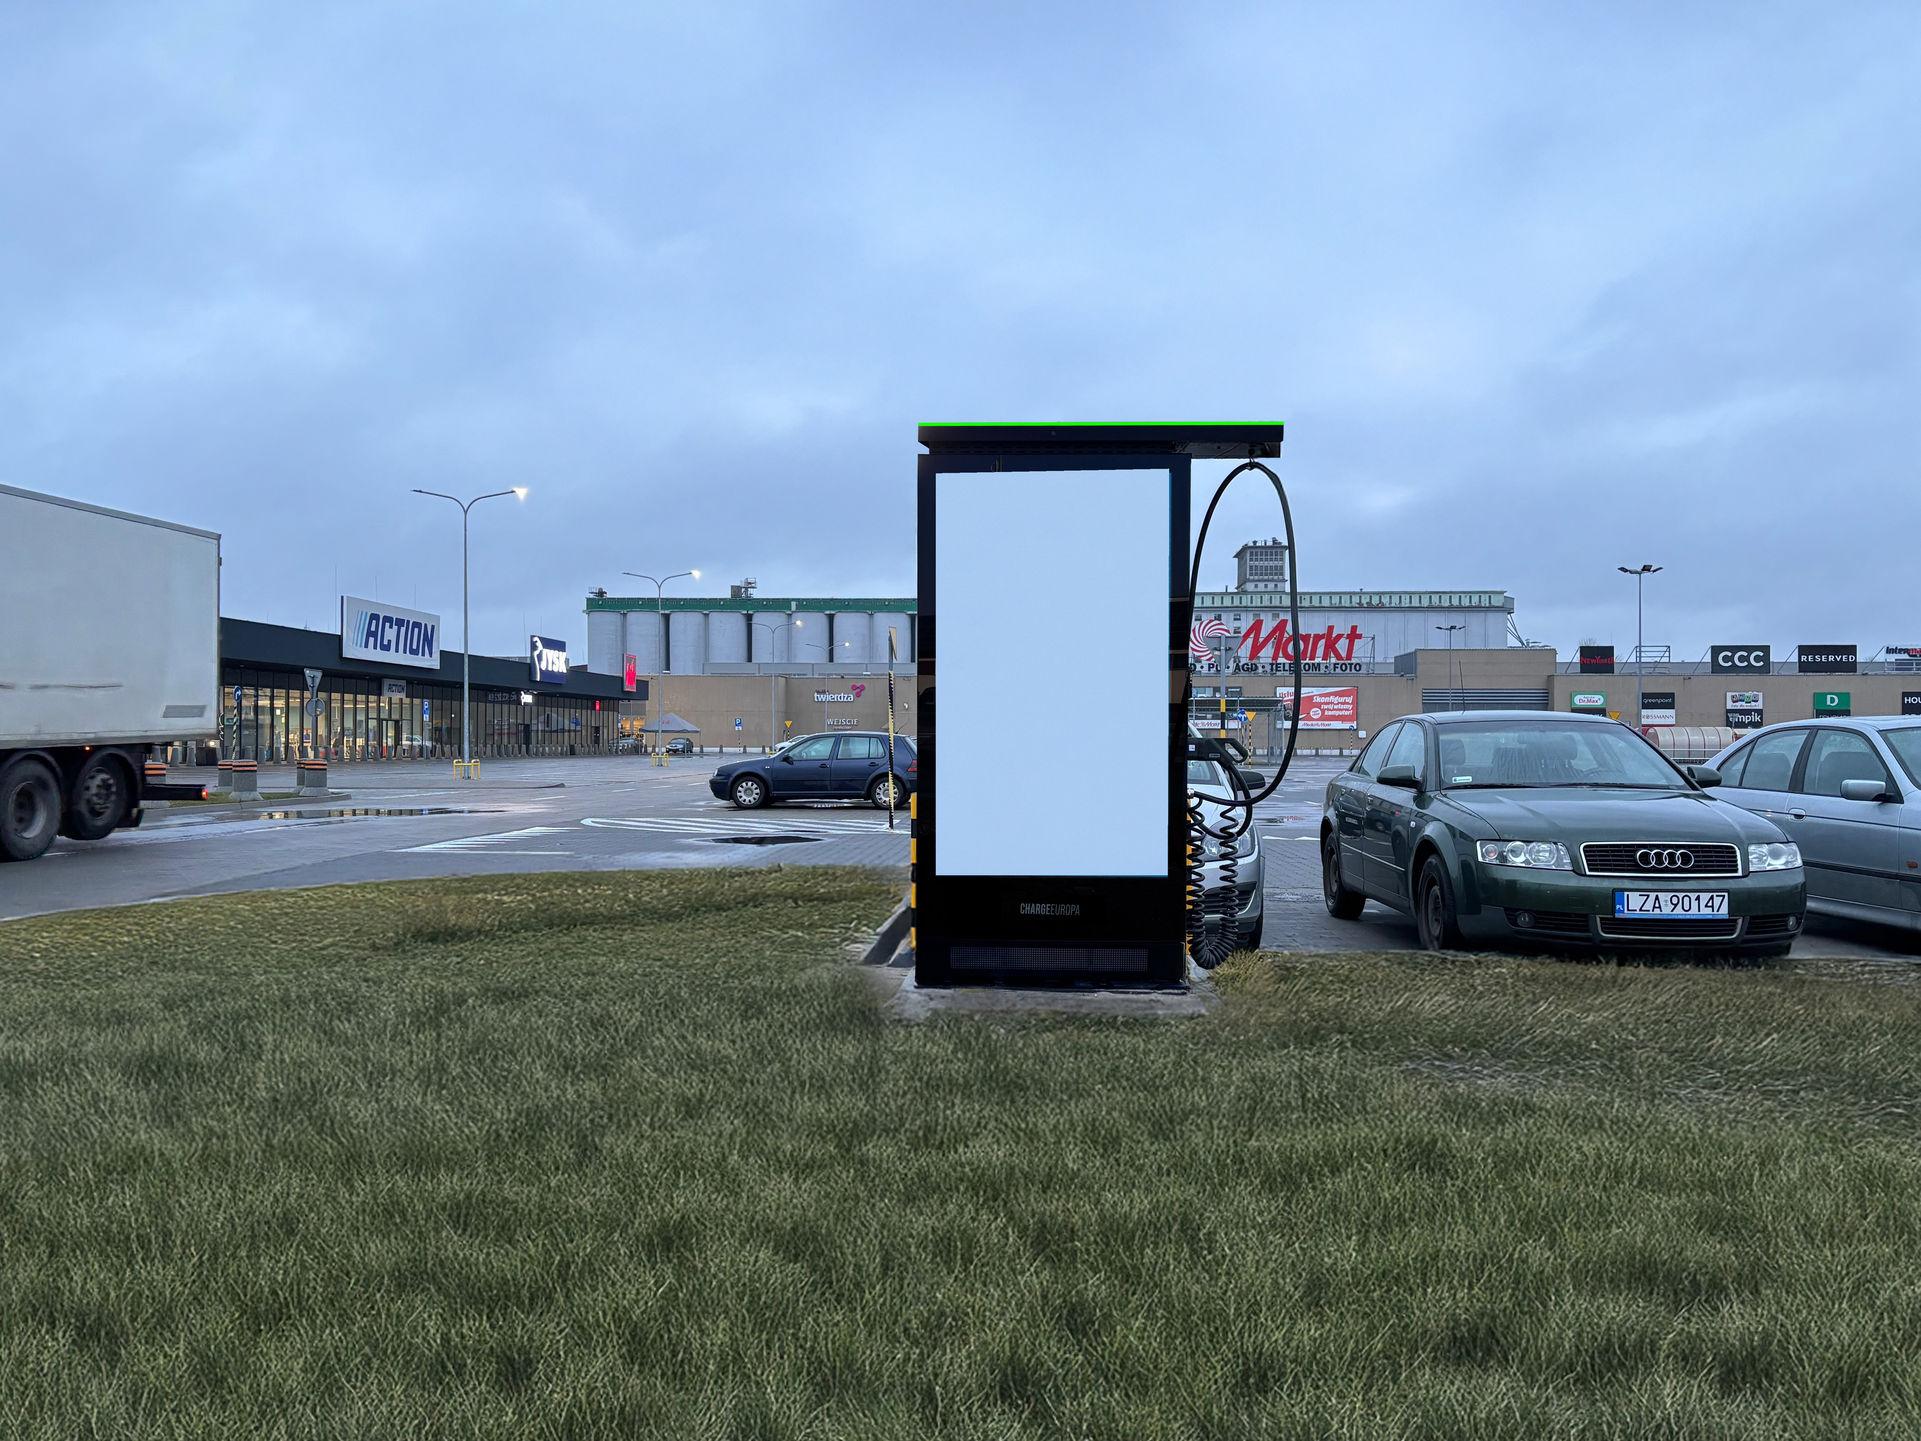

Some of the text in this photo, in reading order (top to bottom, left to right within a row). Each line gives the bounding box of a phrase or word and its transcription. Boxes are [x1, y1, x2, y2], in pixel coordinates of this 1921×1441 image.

[364, 612, 436, 659] ACTION
[1237, 618, 1363, 662] Markt
[540, 648, 567, 673] JYSK
[1234, 662, 1258, 672] AGD
[1269, 662, 1321, 672] TELEOM
[1333, 662, 1362, 672] FOTO
[1718, 650, 1765, 667] CCC
[814, 692, 854, 702] twierdza
[1826, 695, 1839, 706] D
[1626, 893, 1663, 912] LZA
[1669, 894, 1726, 912] 90147
